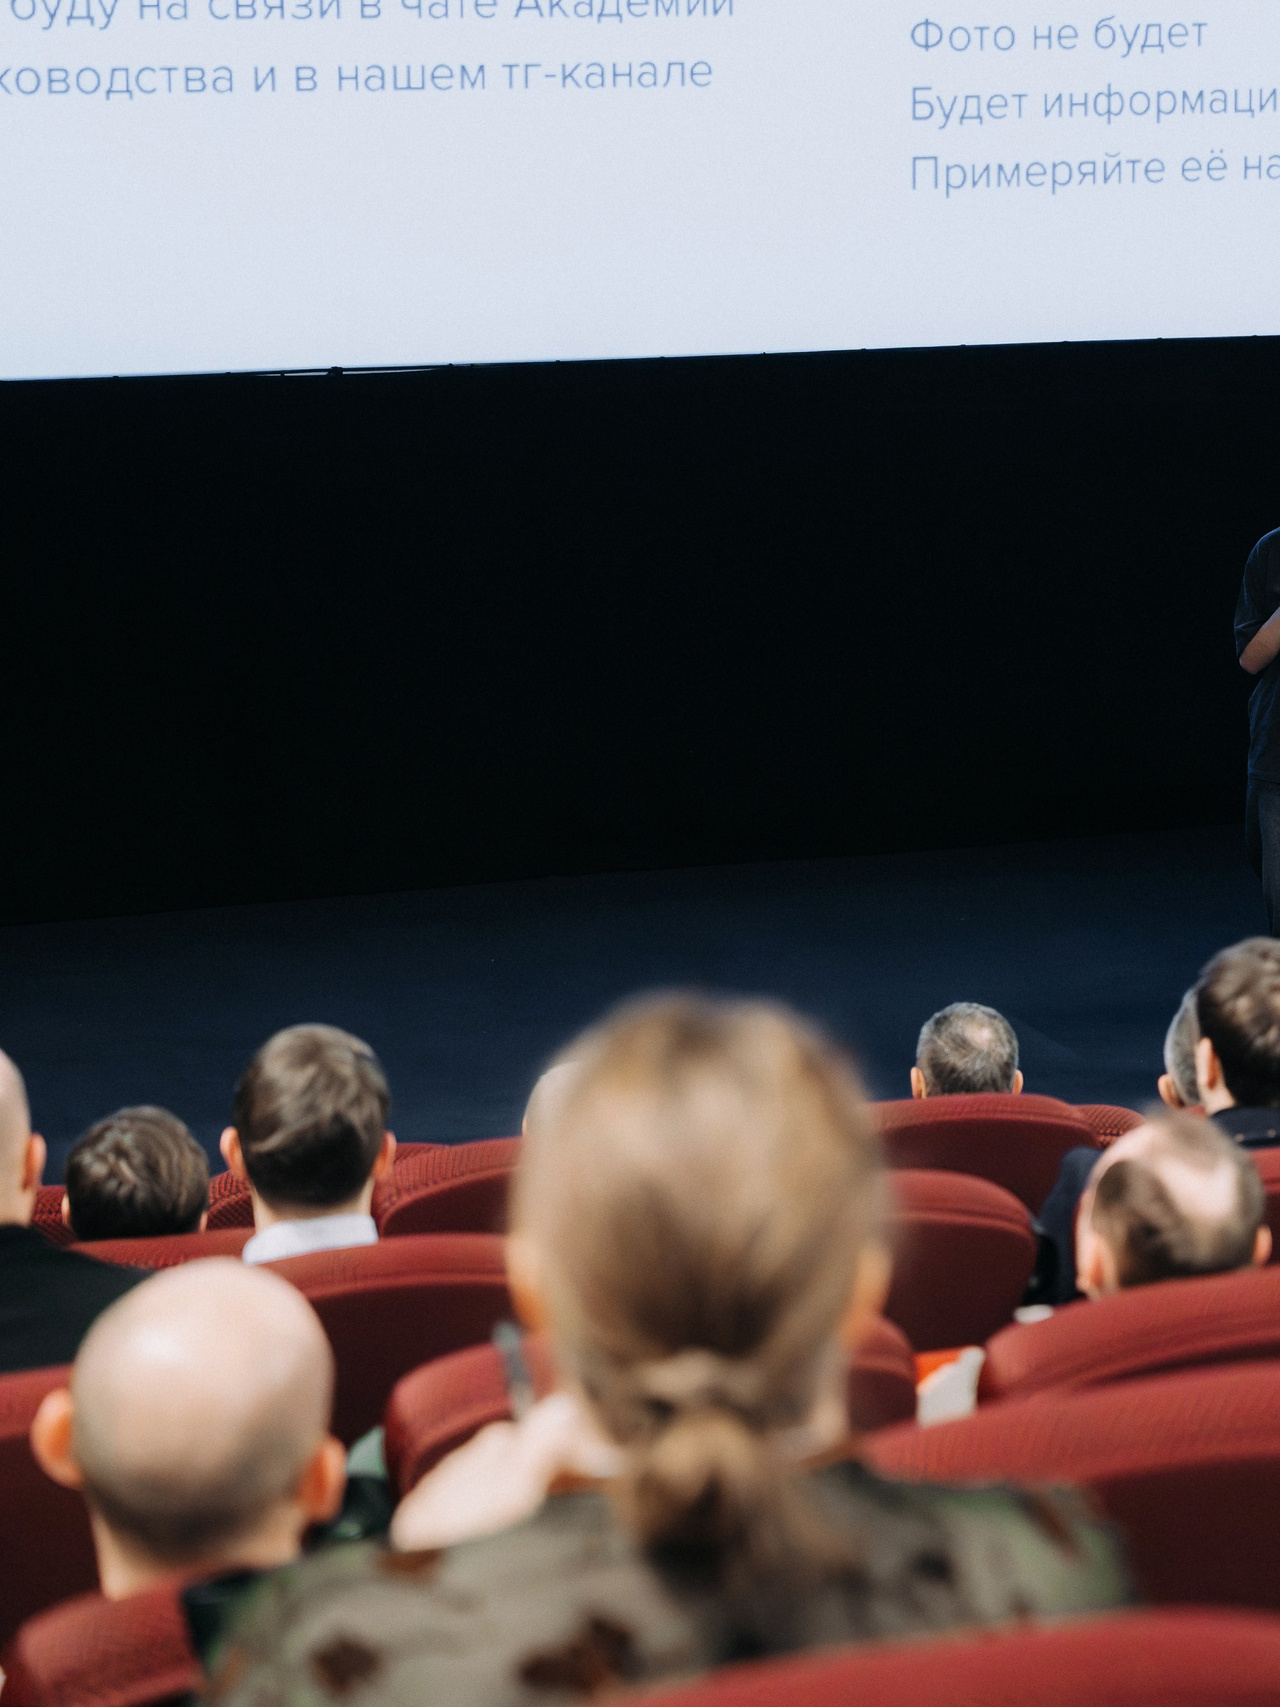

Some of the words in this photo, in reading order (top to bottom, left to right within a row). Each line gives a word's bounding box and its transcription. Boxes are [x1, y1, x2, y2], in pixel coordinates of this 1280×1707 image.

[139, 0, 188, 20] на
[209, 0, 341, 20] связи
[360, 0, 382, 19] в
[911, 18, 1016, 51] Фото
[1033, 24, 1079, 50] не
[1094, 15, 1208, 58] будет
[254, 66, 277, 92] и
[295, 66, 318, 92] в
[338, 63, 486, 92] нашем
[502, 61, 713, 90] тг-канале
[911, 86, 1029, 129] Будет
[912, 151, 1166, 199] Примеряйте
[1181, 149, 1228, 182] её
